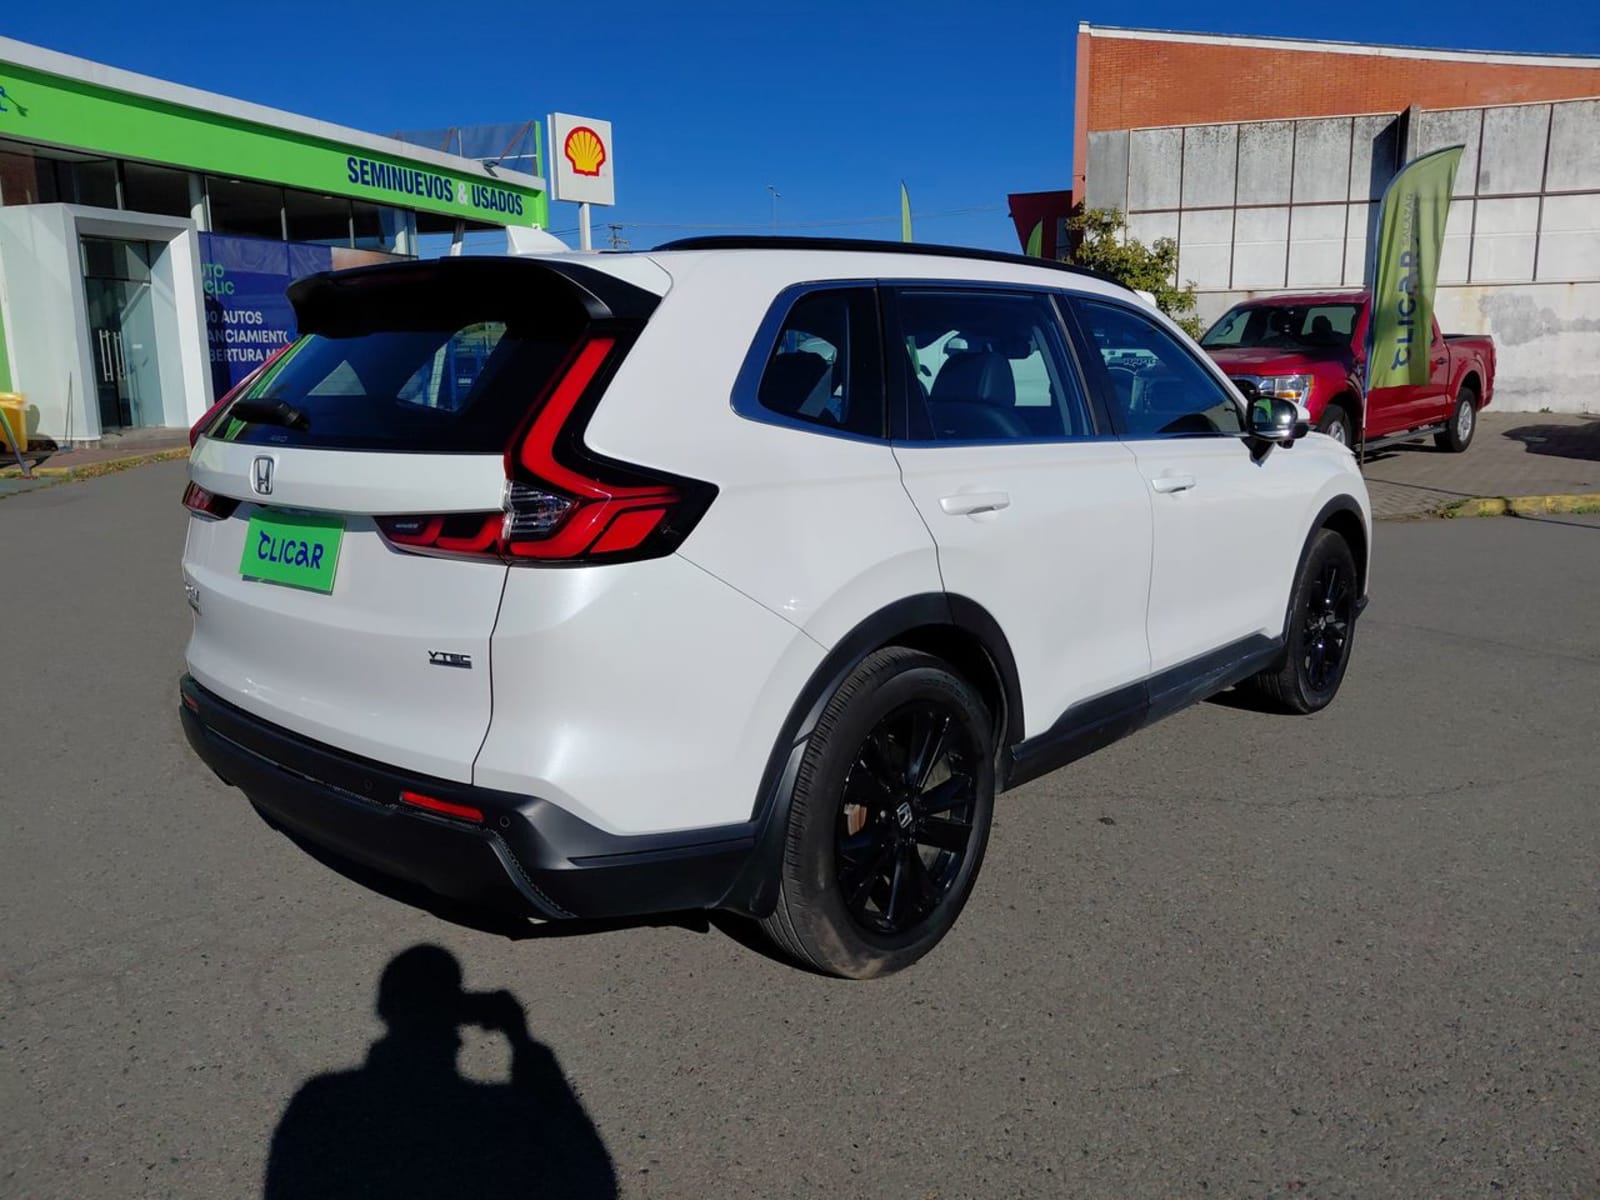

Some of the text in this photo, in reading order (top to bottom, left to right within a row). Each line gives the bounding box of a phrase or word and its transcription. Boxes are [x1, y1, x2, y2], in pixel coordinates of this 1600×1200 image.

[347, 156, 524, 216] SEMINUEVOS & USADOS
[221, 309, 263, 324] AUTOS
